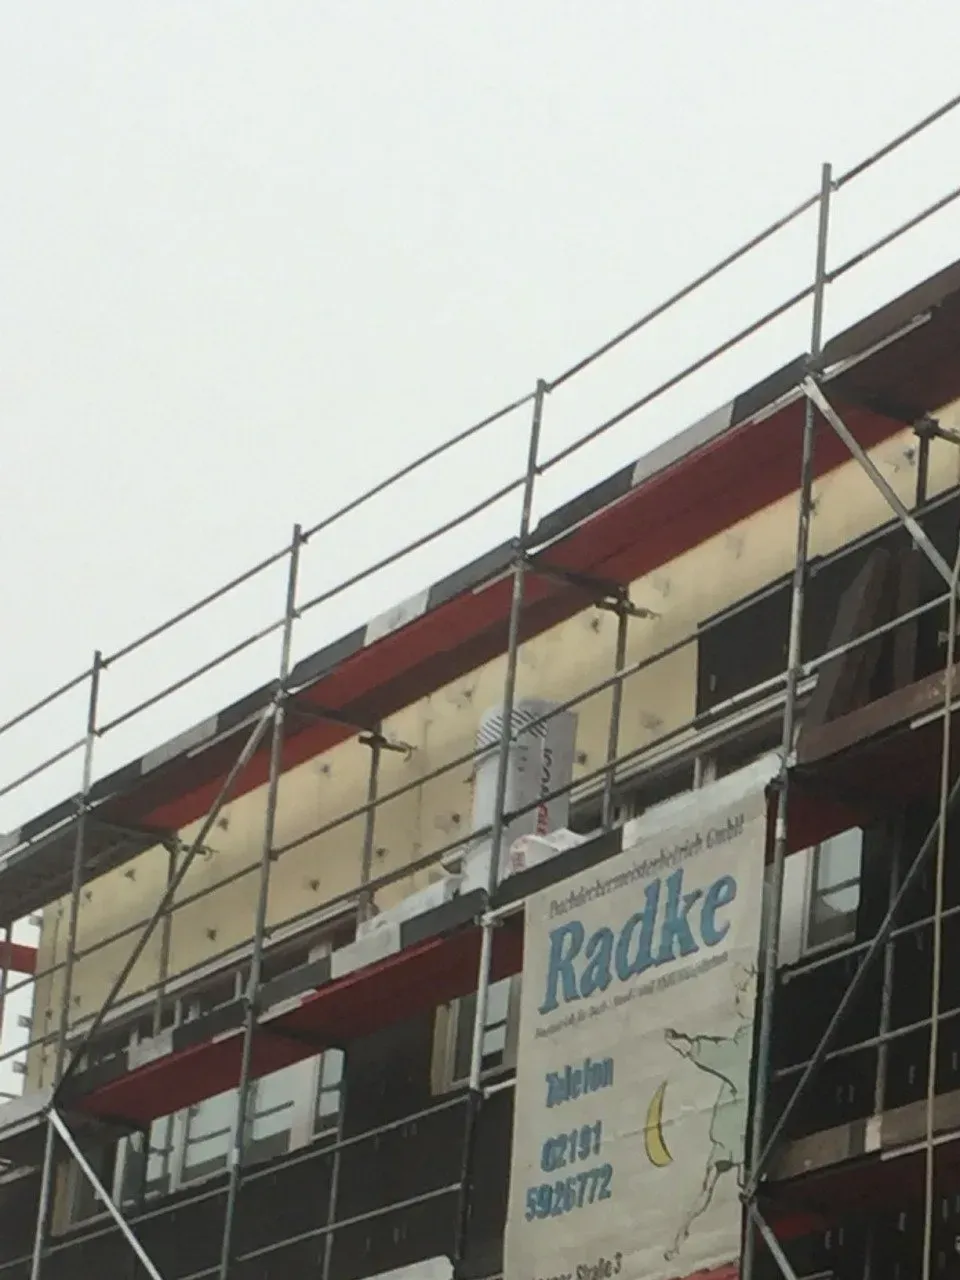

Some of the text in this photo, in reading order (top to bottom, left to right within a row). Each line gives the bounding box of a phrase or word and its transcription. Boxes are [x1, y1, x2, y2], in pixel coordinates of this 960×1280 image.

[537, 868, 738, 1016] Radke
[546, 1057, 614, 1108] Telefon
[541, 1119, 602, 1173] 02191
[525, 1163, 613, 1222] 5926772
